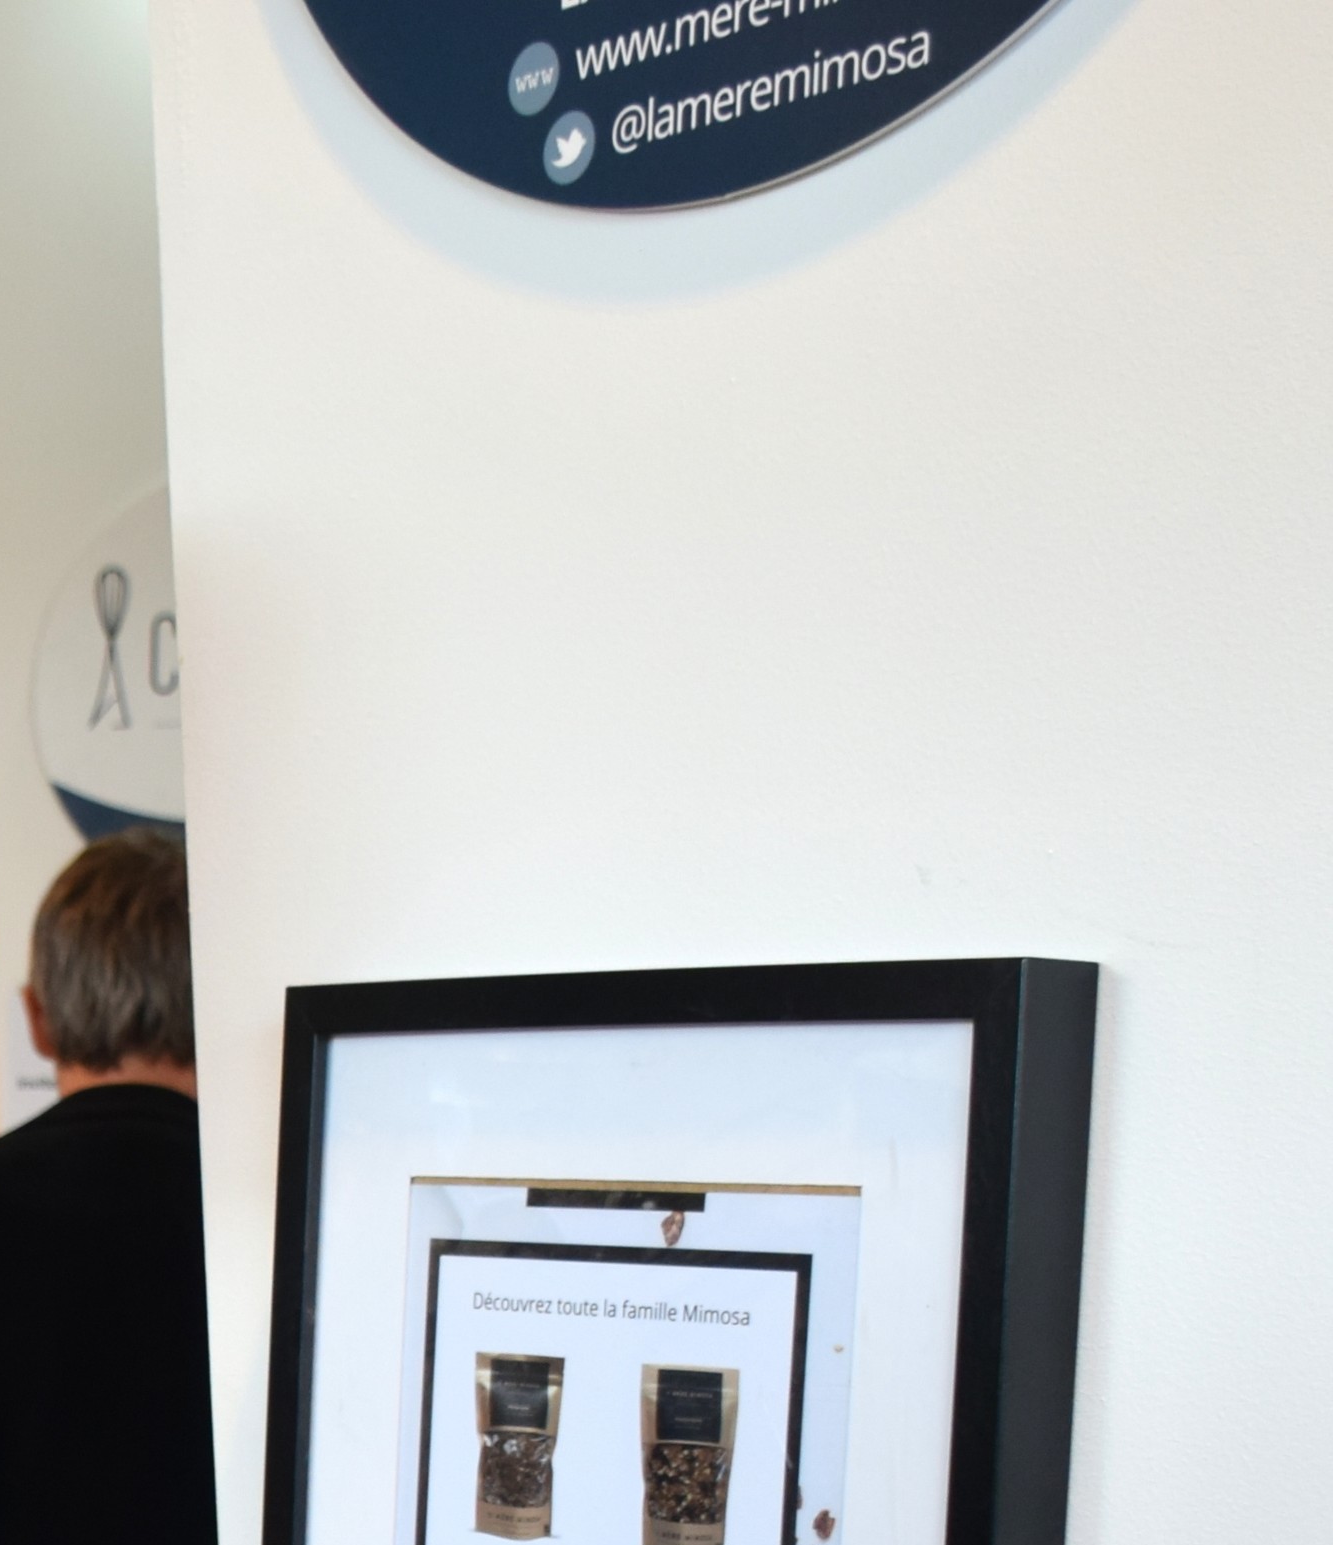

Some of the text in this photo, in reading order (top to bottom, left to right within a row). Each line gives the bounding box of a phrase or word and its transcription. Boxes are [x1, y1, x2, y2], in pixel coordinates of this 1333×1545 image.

[611, 30, 931, 154] @lameremimosa
[473, 1292, 751, 1327] Découvrez toute la famille Mimosa
